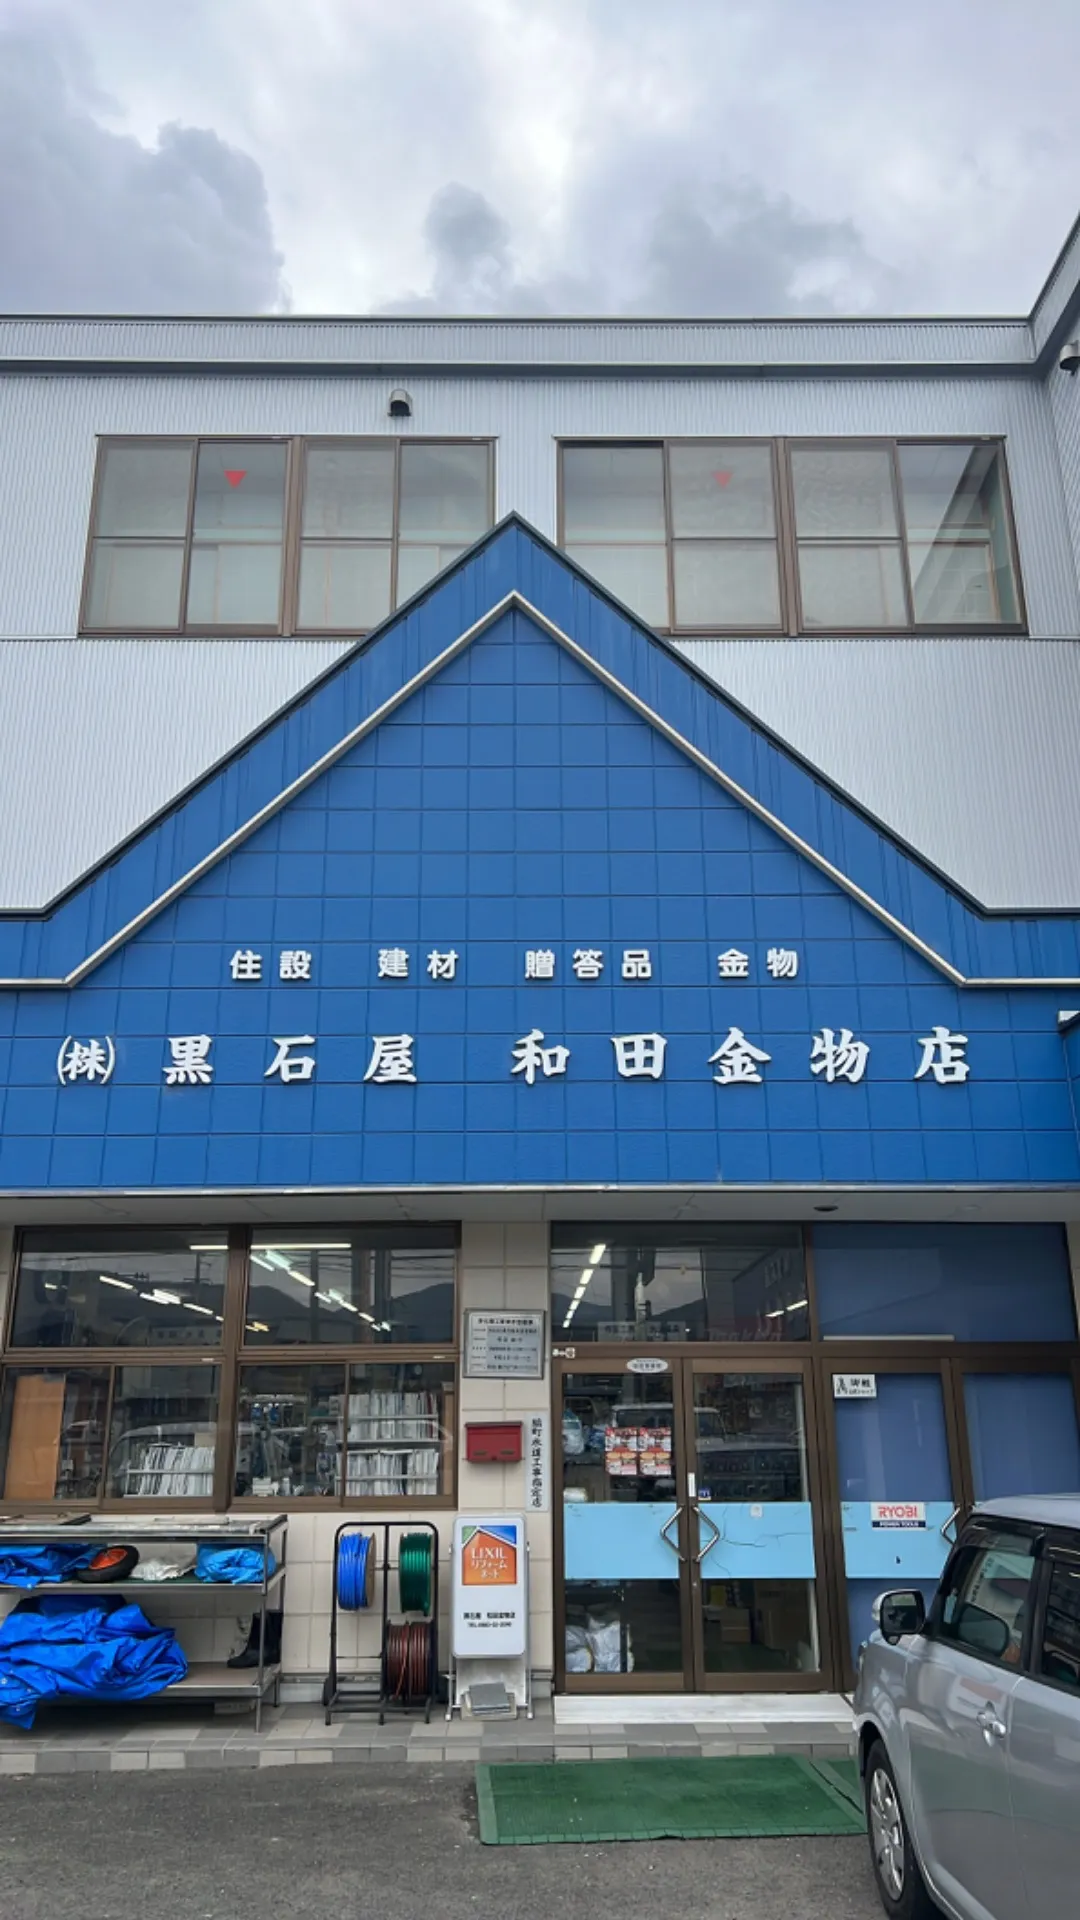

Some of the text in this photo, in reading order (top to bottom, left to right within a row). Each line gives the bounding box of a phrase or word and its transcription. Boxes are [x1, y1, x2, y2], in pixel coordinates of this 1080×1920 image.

[230, 947, 798, 980] 住設 建材 贈答品 金物
[510, 1026, 970, 1085] 和田金物店
[878, 1505, 918, 1518] RYOBI
[471, 1547, 507, 1559] LIXIL
[471, 1559, 508, 1569] リフォーム
